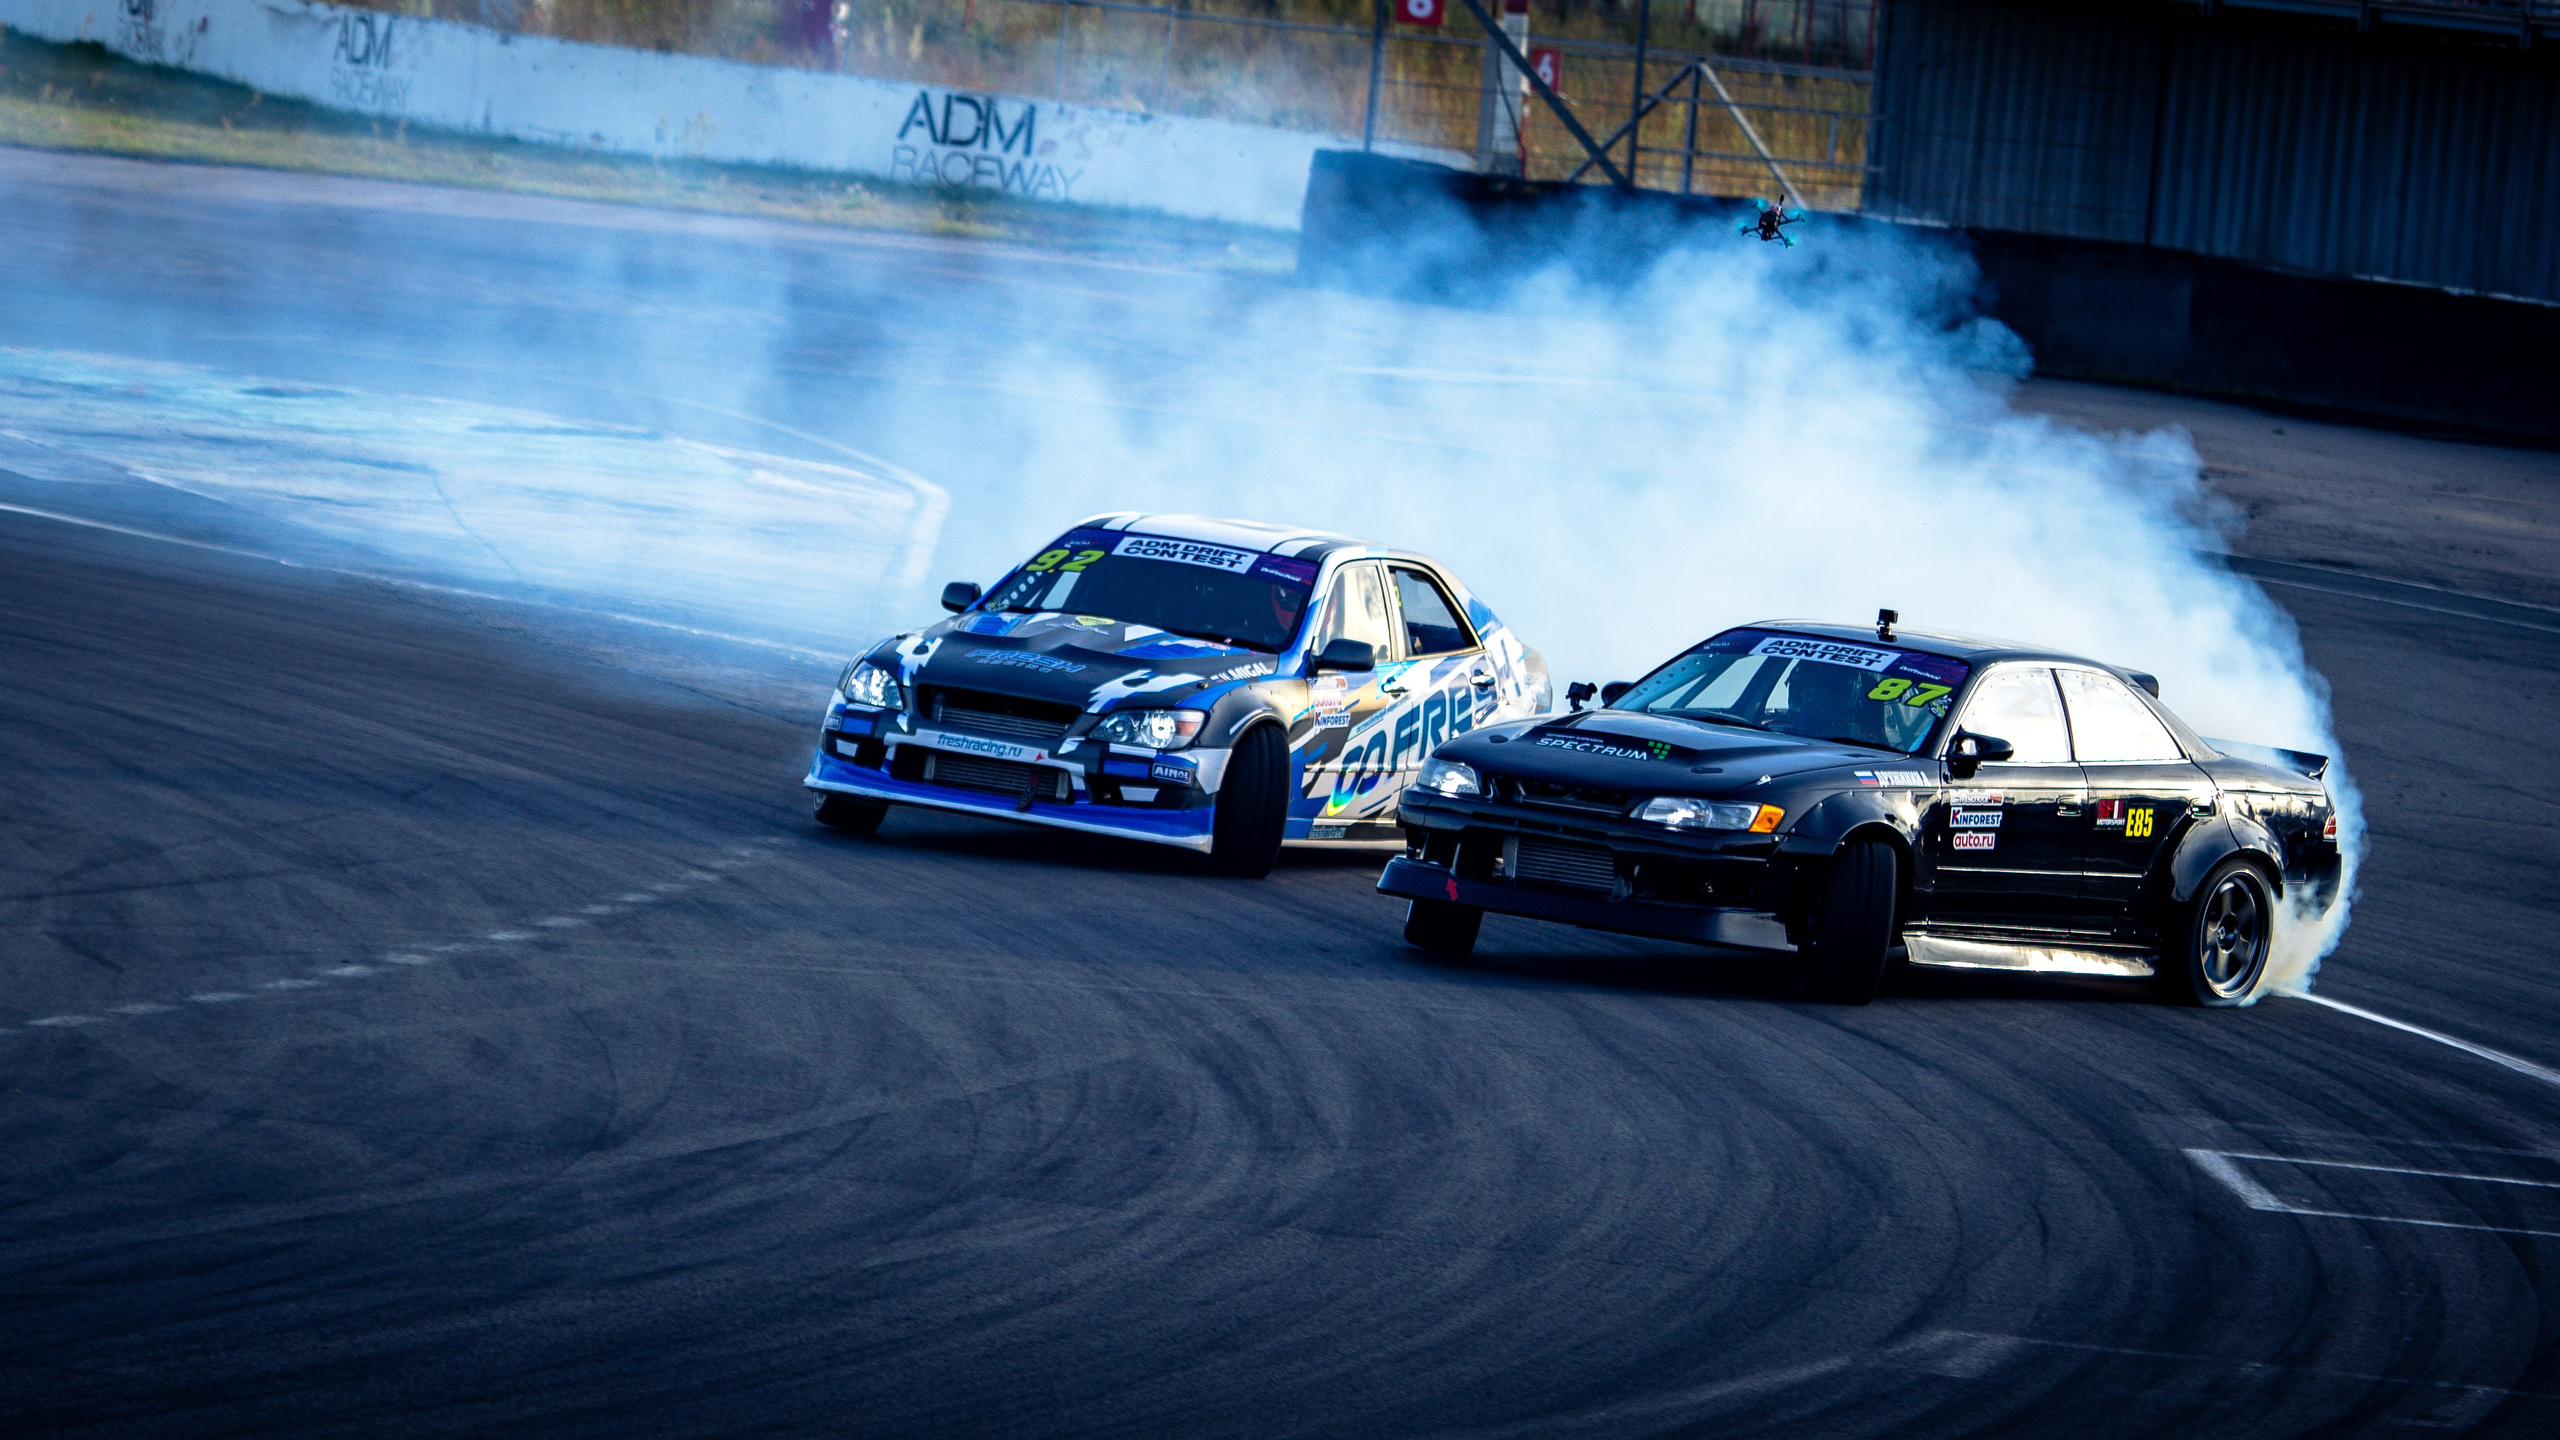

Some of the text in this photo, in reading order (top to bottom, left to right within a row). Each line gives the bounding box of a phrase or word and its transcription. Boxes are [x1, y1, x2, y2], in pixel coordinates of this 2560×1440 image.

[333, 13, 393, 70] ADM
[897, 90, 1037, 157] ADM
[890, 144, 1084, 200] RACEWAY
[1026, 549, 1105, 572] 92
[1123, 547, 1243, 569] CONTEST
[1130, 539, 1248, 561] ADM DRIFT
[965, 649, 1087, 673] FRESH
[1767, 640, 1890, 660] ADM DRIFT
[1767, 647, 1882, 668] CONTEST
[1868, 677, 1953, 707] 87
[937, 734, 1024, 757] freshracing.ru
[1536, 738, 1647, 761] SPECTRUM
[1951, 809, 2001, 825] KINFOREST
[2125, 808, 2154, 837] E85
[1954, 833, 1994, 848] auto.ru
